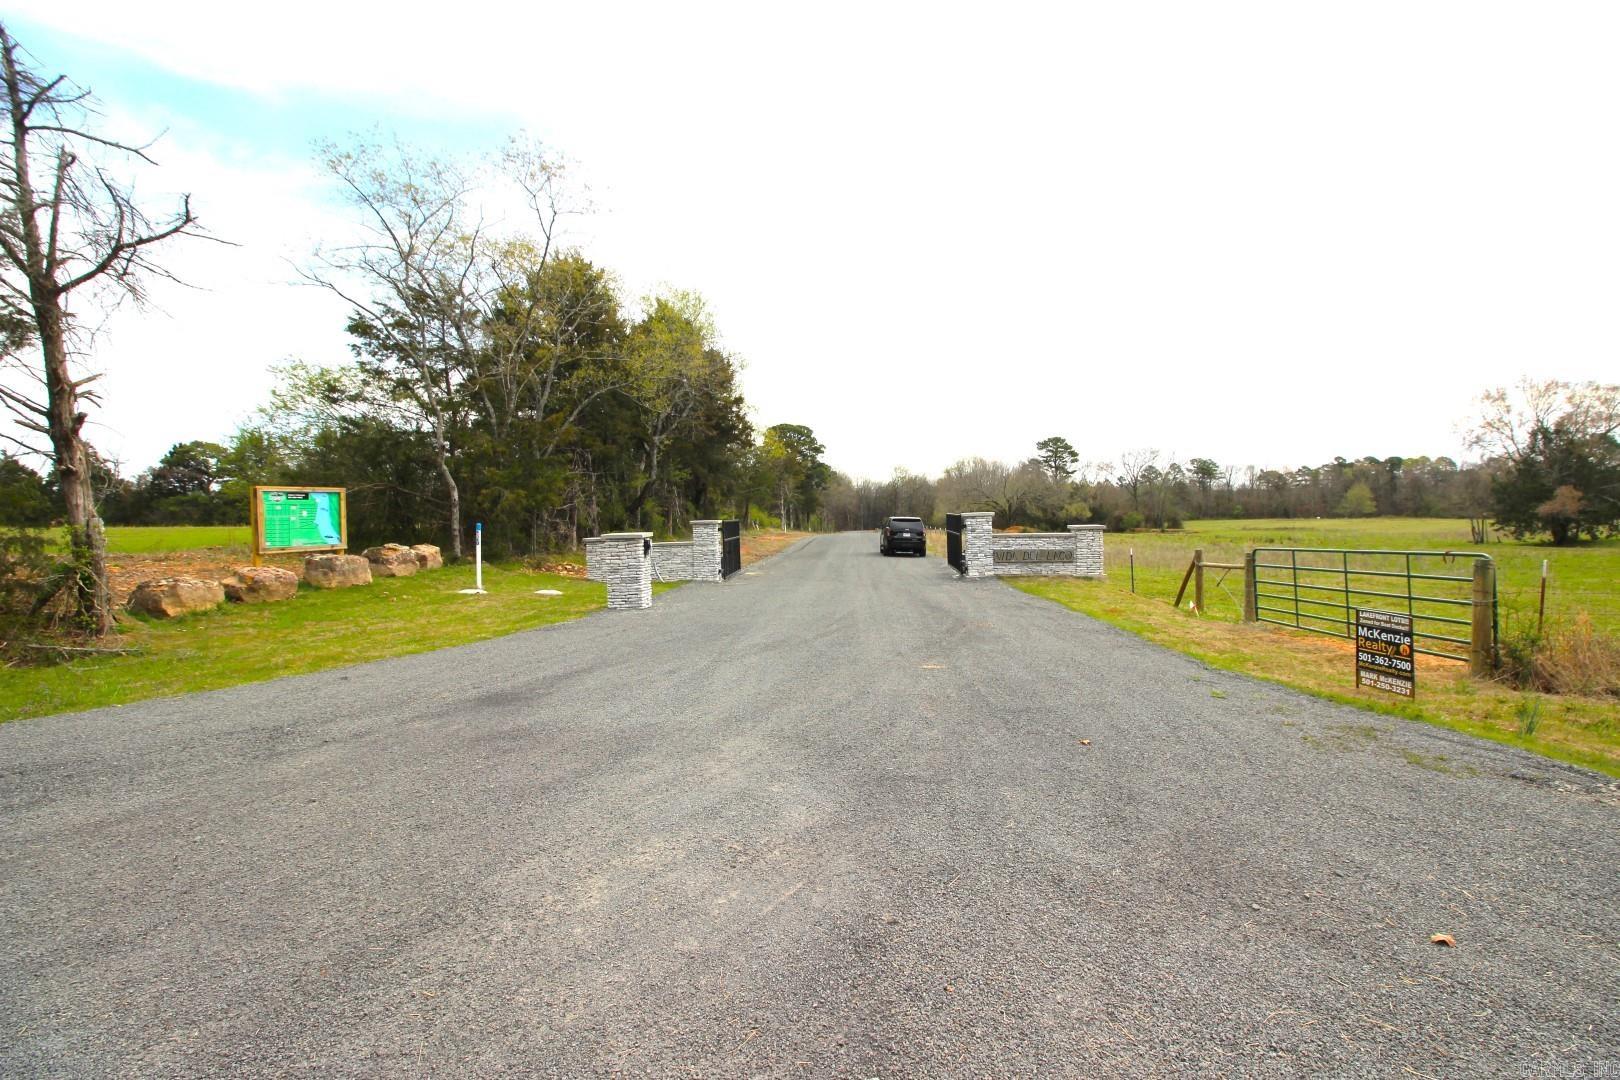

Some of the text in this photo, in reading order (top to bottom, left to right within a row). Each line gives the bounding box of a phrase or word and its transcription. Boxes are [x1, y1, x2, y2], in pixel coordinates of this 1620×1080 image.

[1359, 611, 1390, 621] LAKEFRONT
[1358, 626, 1411, 645] McKenzie
[1359, 637, 1393, 655] Realty
[1358, 652, 1411, 671] 501-362-7500
[1360, 670, 1412, 688] MARK McKENZIE
[1361, 677, 1410, 696] 501-250-3231
